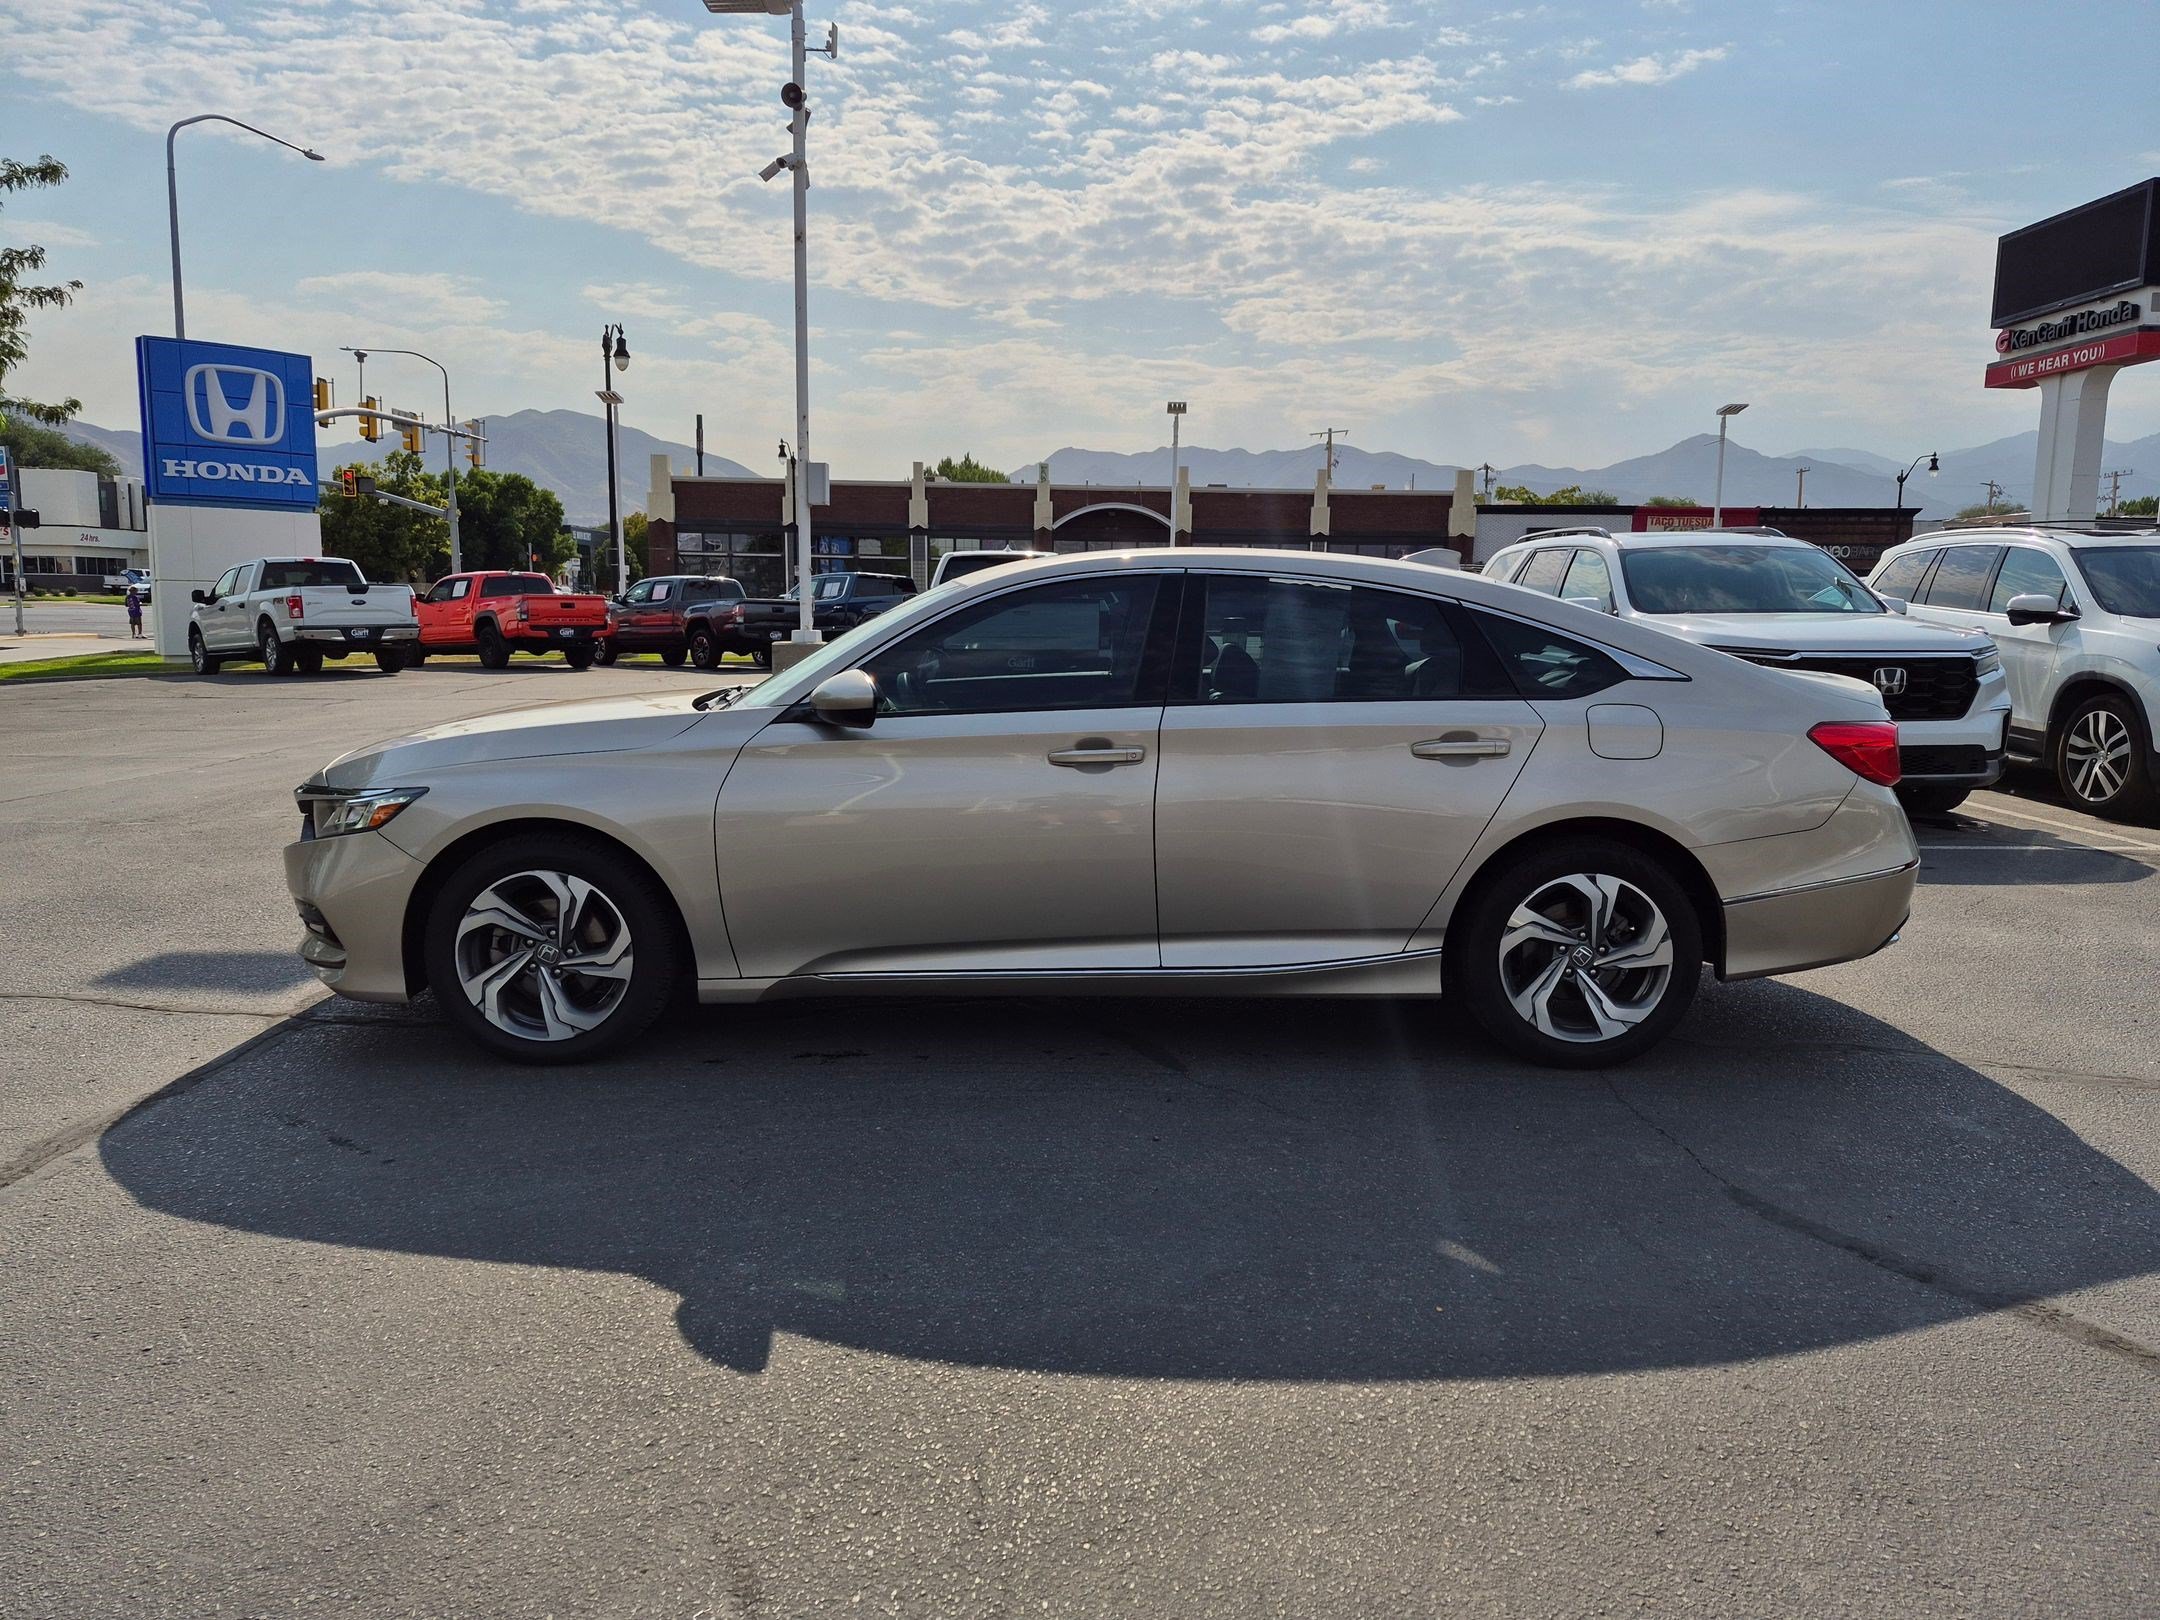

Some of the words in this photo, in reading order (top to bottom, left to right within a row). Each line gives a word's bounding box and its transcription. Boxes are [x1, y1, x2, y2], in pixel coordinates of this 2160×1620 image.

[2076, 301, 2133, 332] Honda
[2018, 361, 2036, 377] WE
[2038, 353, 2069, 372] HEAR
[2073, 346, 2098, 364] YOU
[162, 459, 312, 486] HONDA
[1650, 516, 1674, 527] TACO
[1676, 517, 1714, 528] TUESDA
[80, 533, 89, 542] 24
[1820, 545, 1851, 558] NGO
